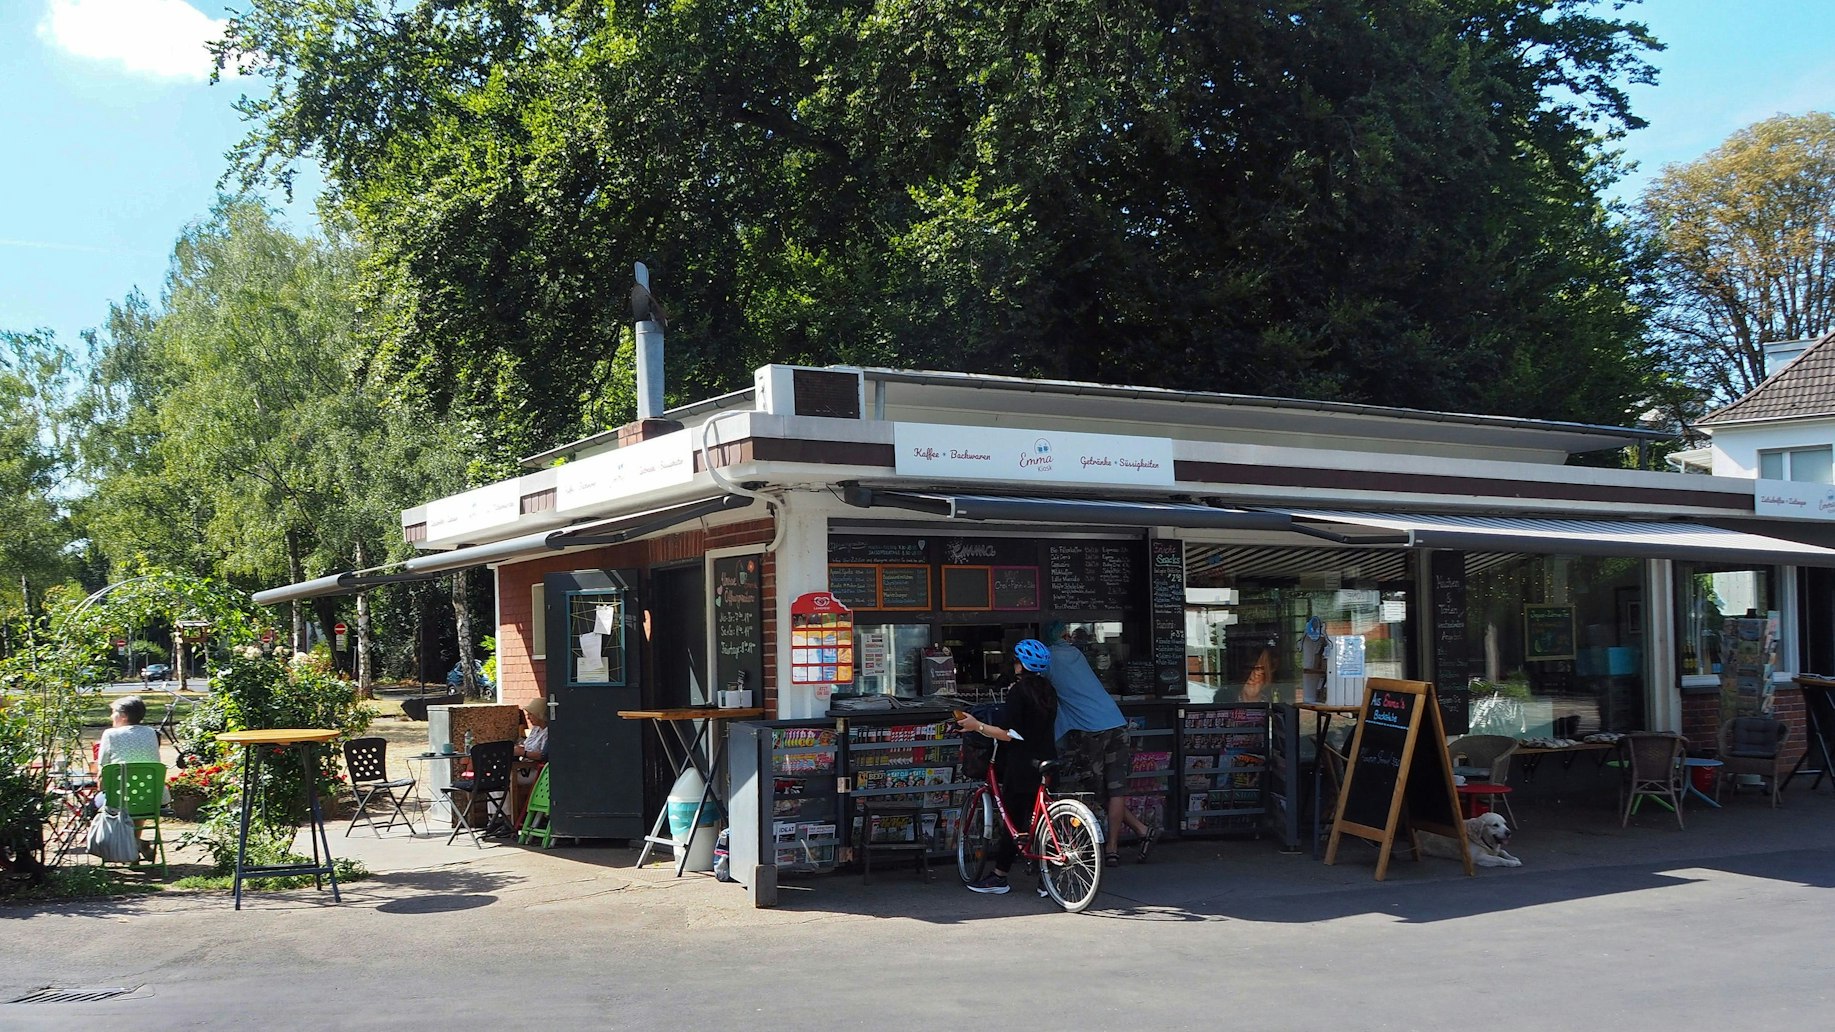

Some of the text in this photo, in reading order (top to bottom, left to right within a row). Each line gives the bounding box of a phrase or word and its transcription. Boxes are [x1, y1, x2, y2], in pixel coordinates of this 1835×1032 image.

[913, 447, 991, 461] Kaffee Backwaren
[1019, 452, 1054, 469] Emma
[1037, 464, 1053, 472] Kiosk
[1080, 456, 1112, 469] Getränke
[1156, 553, 1181, 565] Snacks
